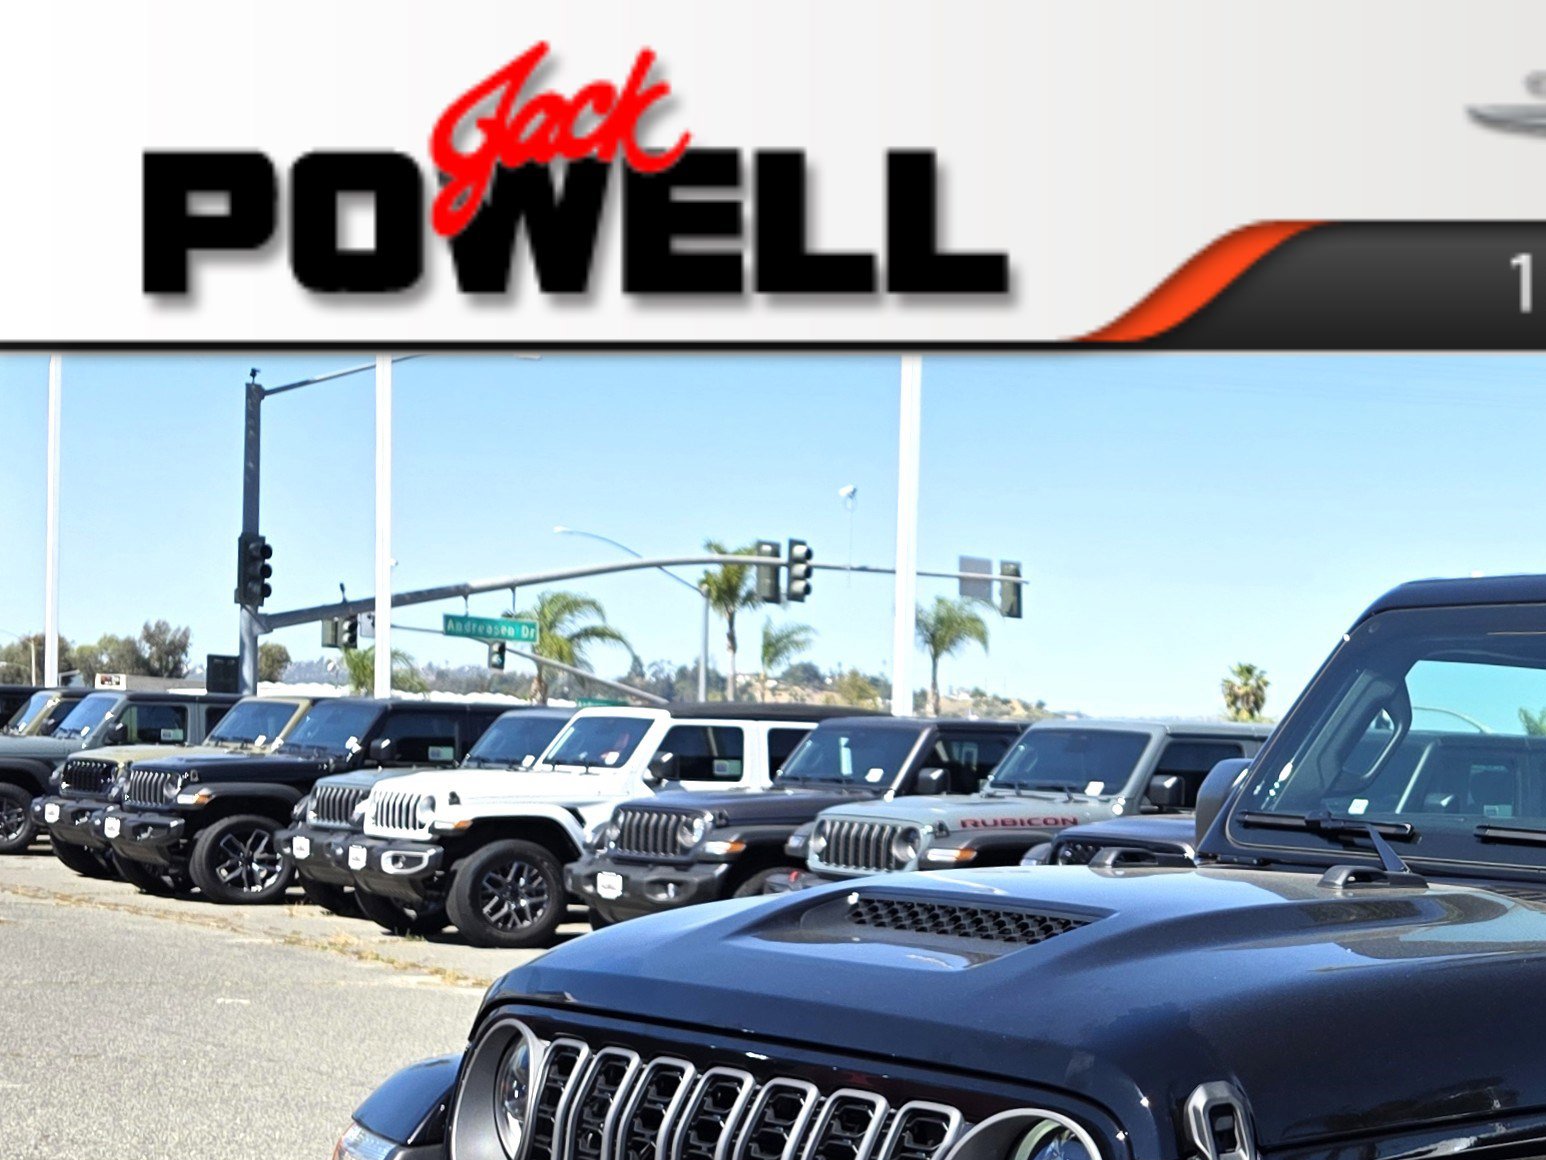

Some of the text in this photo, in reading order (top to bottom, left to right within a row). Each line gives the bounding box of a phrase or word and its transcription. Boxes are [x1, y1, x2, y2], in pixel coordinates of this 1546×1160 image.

[447, 618, 535, 638] Andreasen Dr
[960, 816, 1078, 828] RUBICON
